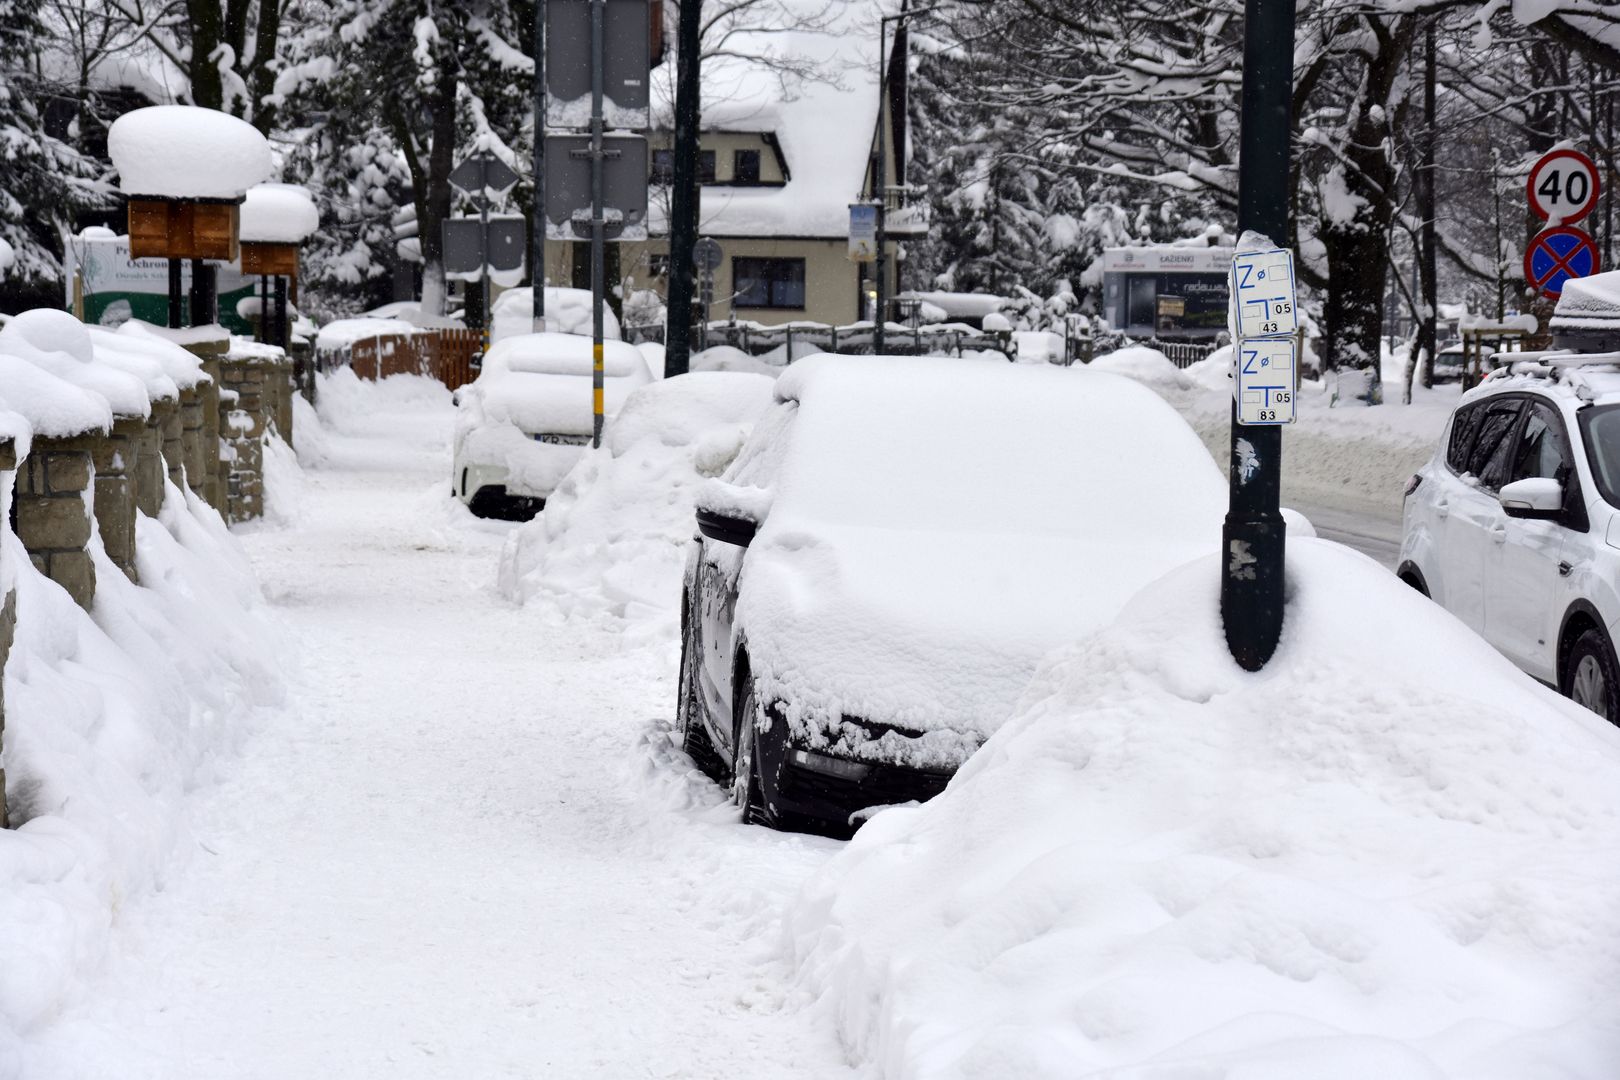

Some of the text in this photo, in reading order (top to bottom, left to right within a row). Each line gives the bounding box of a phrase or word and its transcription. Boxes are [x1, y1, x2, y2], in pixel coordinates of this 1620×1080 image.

[1538, 169, 1588, 205] 40
[1238, 264, 1255, 289] Z
[1275, 303, 1291, 314] 05
[1263, 323, 1278, 333] 43
[1242, 350, 1258, 374] Z
[1276, 393, 1290, 403] 05
[1260, 411, 1276, 420] 83
